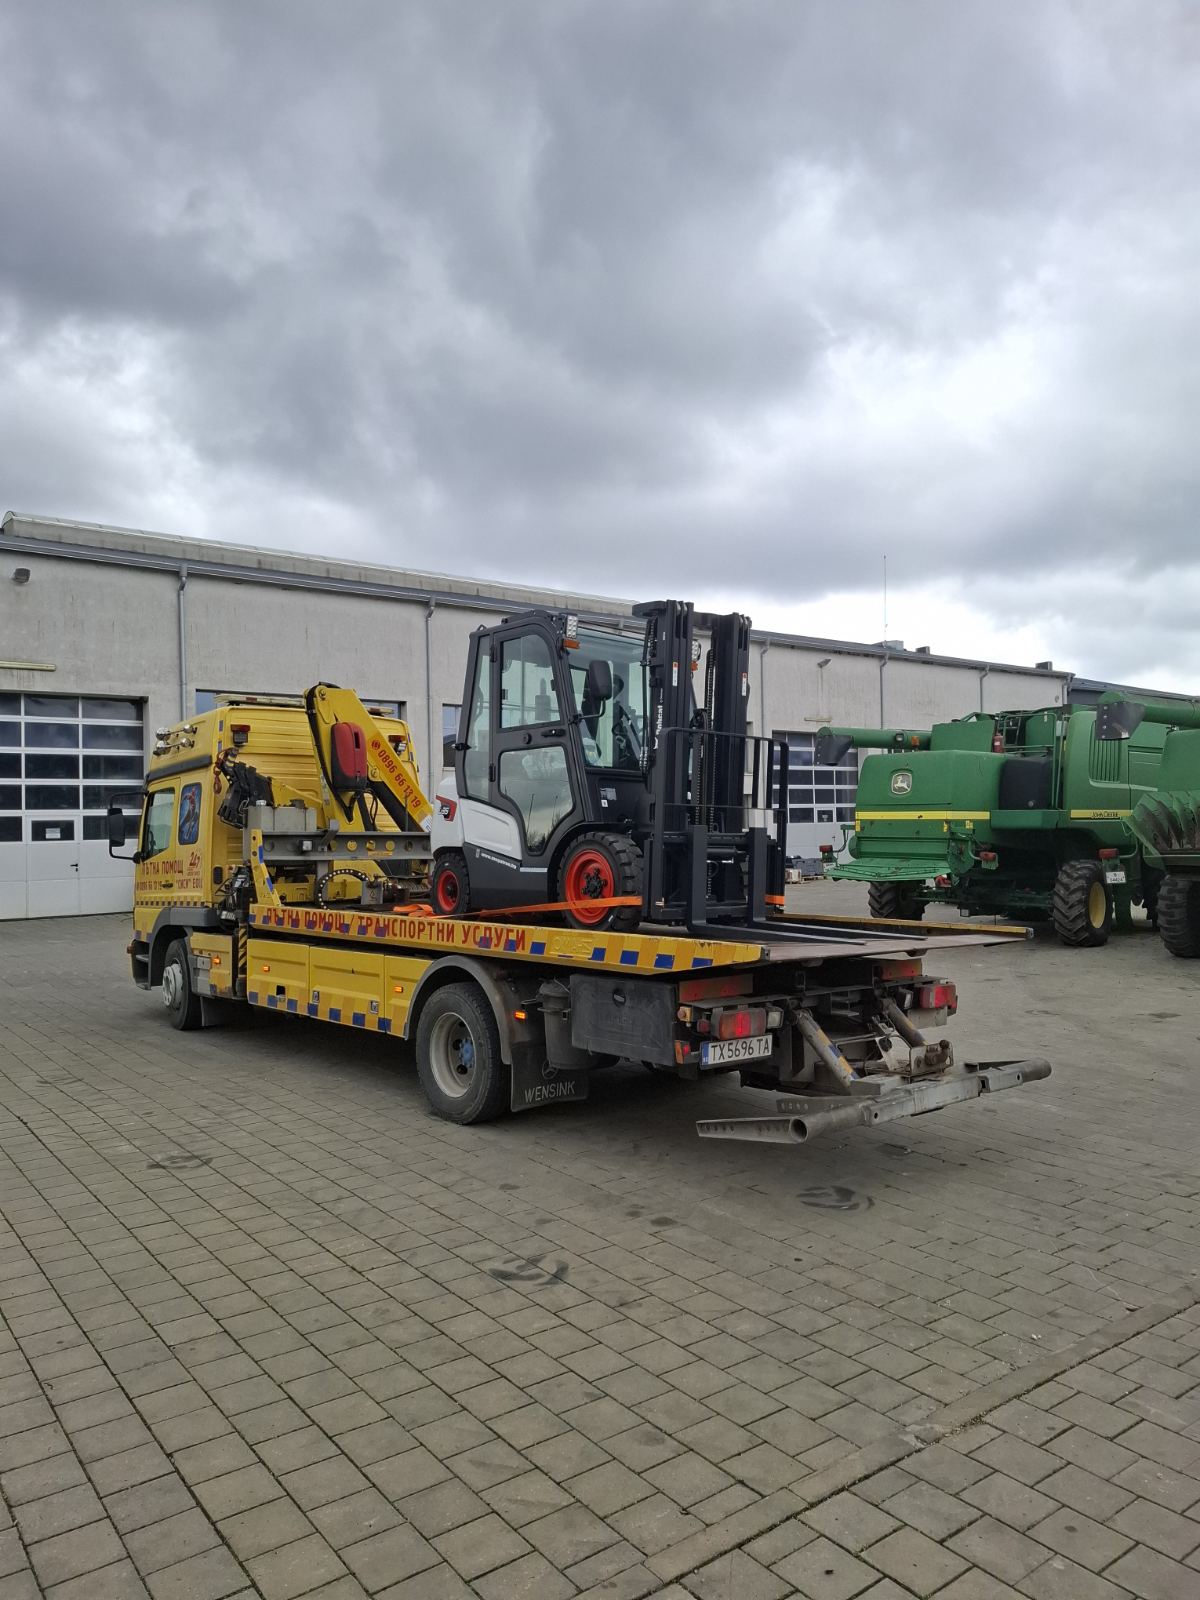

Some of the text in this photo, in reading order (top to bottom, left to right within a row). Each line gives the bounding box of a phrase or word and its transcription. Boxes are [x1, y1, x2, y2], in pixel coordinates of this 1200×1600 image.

[378, 749, 421, 808] 0896 66 13 19
[141, 862, 160, 875] ПЪТНА
[161, 860, 184, 875] ПОМОЩ
[266, 908, 300, 928] ПЪТНА
[304, 911, 346, 934] ПОМОЩ
[357, 915, 455, 944] ТРАНСПОРТНИ
[461, 925, 526, 951] УСЛУГИ
[524, 1080, 576, 1103] WENSINK
